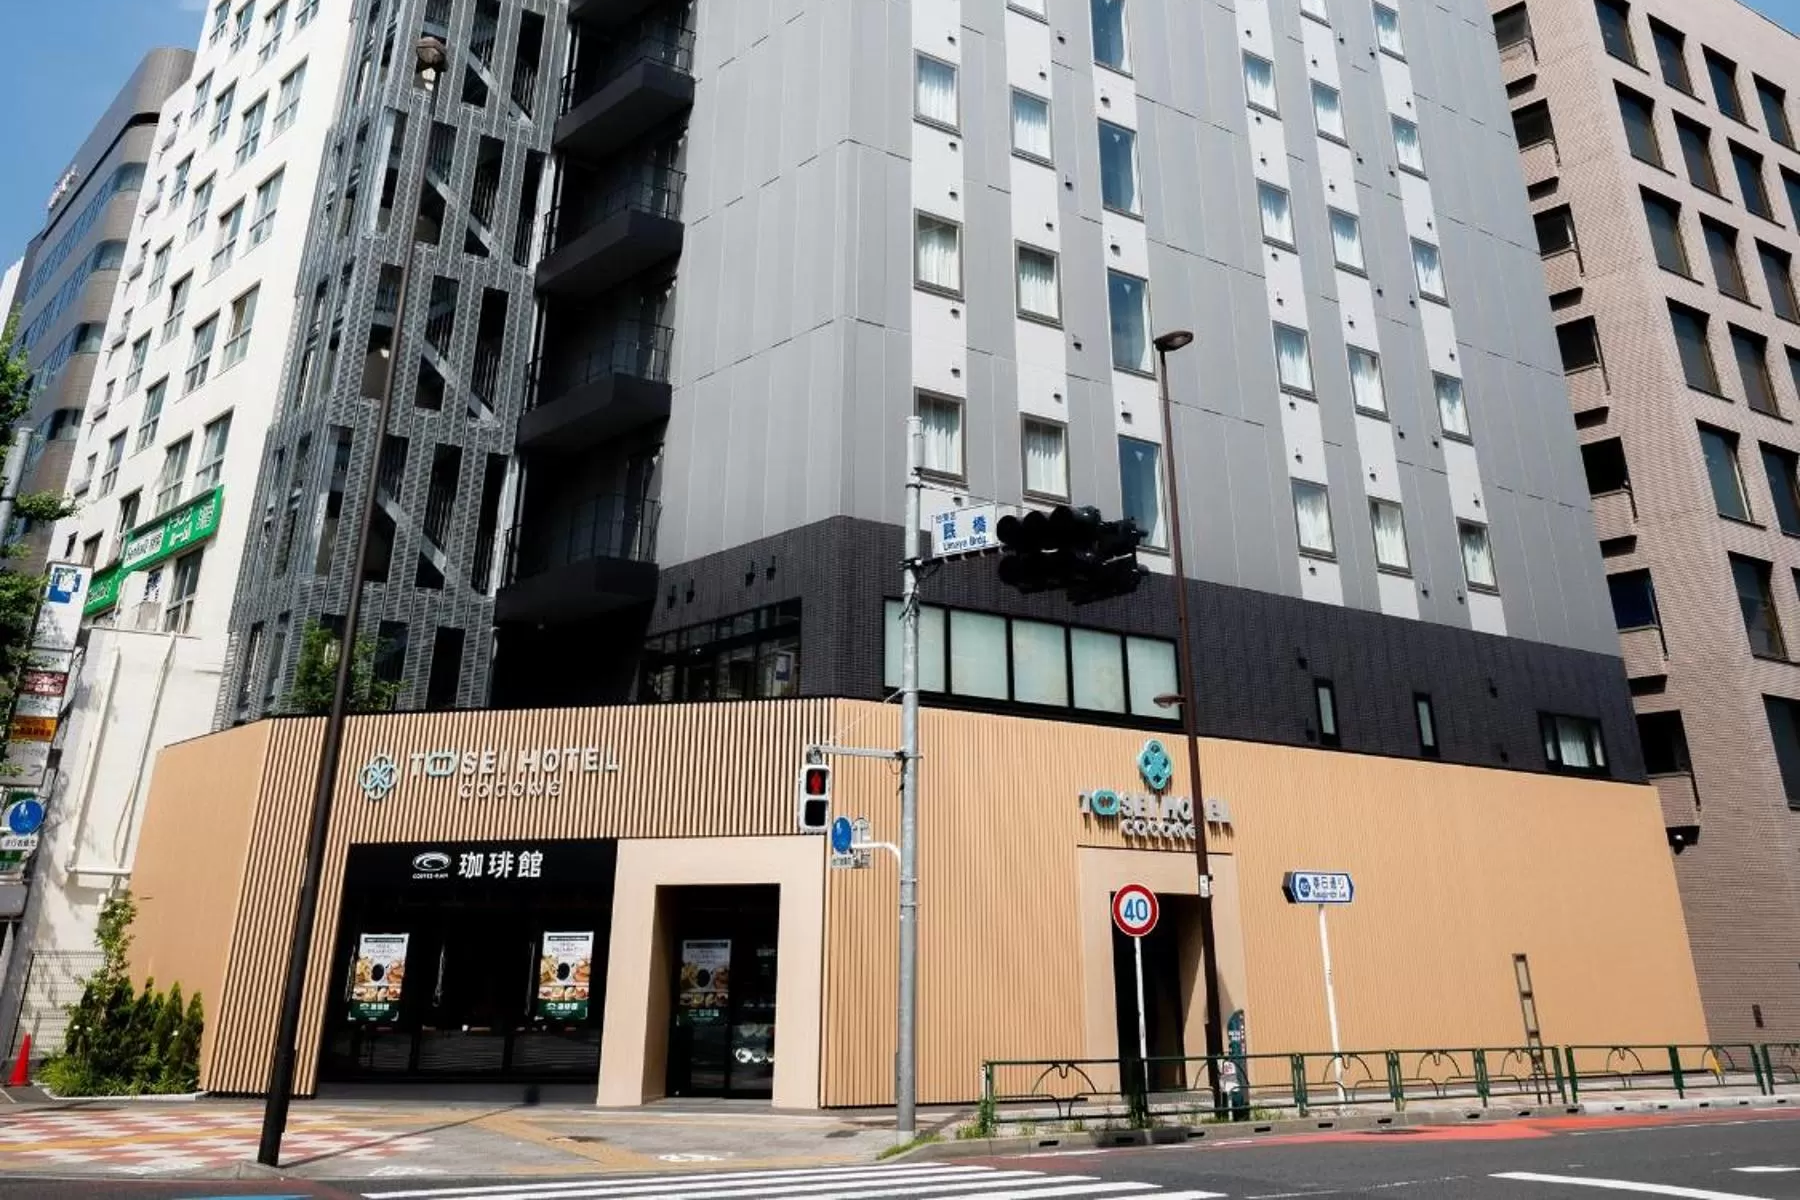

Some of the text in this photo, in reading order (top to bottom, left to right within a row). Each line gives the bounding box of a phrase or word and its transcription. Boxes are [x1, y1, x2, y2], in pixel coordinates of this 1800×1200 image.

[409, 746, 620, 777] TOSEI HOTEL
[458, 780, 562, 799] COCONE
[1078, 788, 1231, 822] TOSEI HOEL
[457, 850, 544, 879] 珈琲館
[1124, 898, 1148, 921] 40
